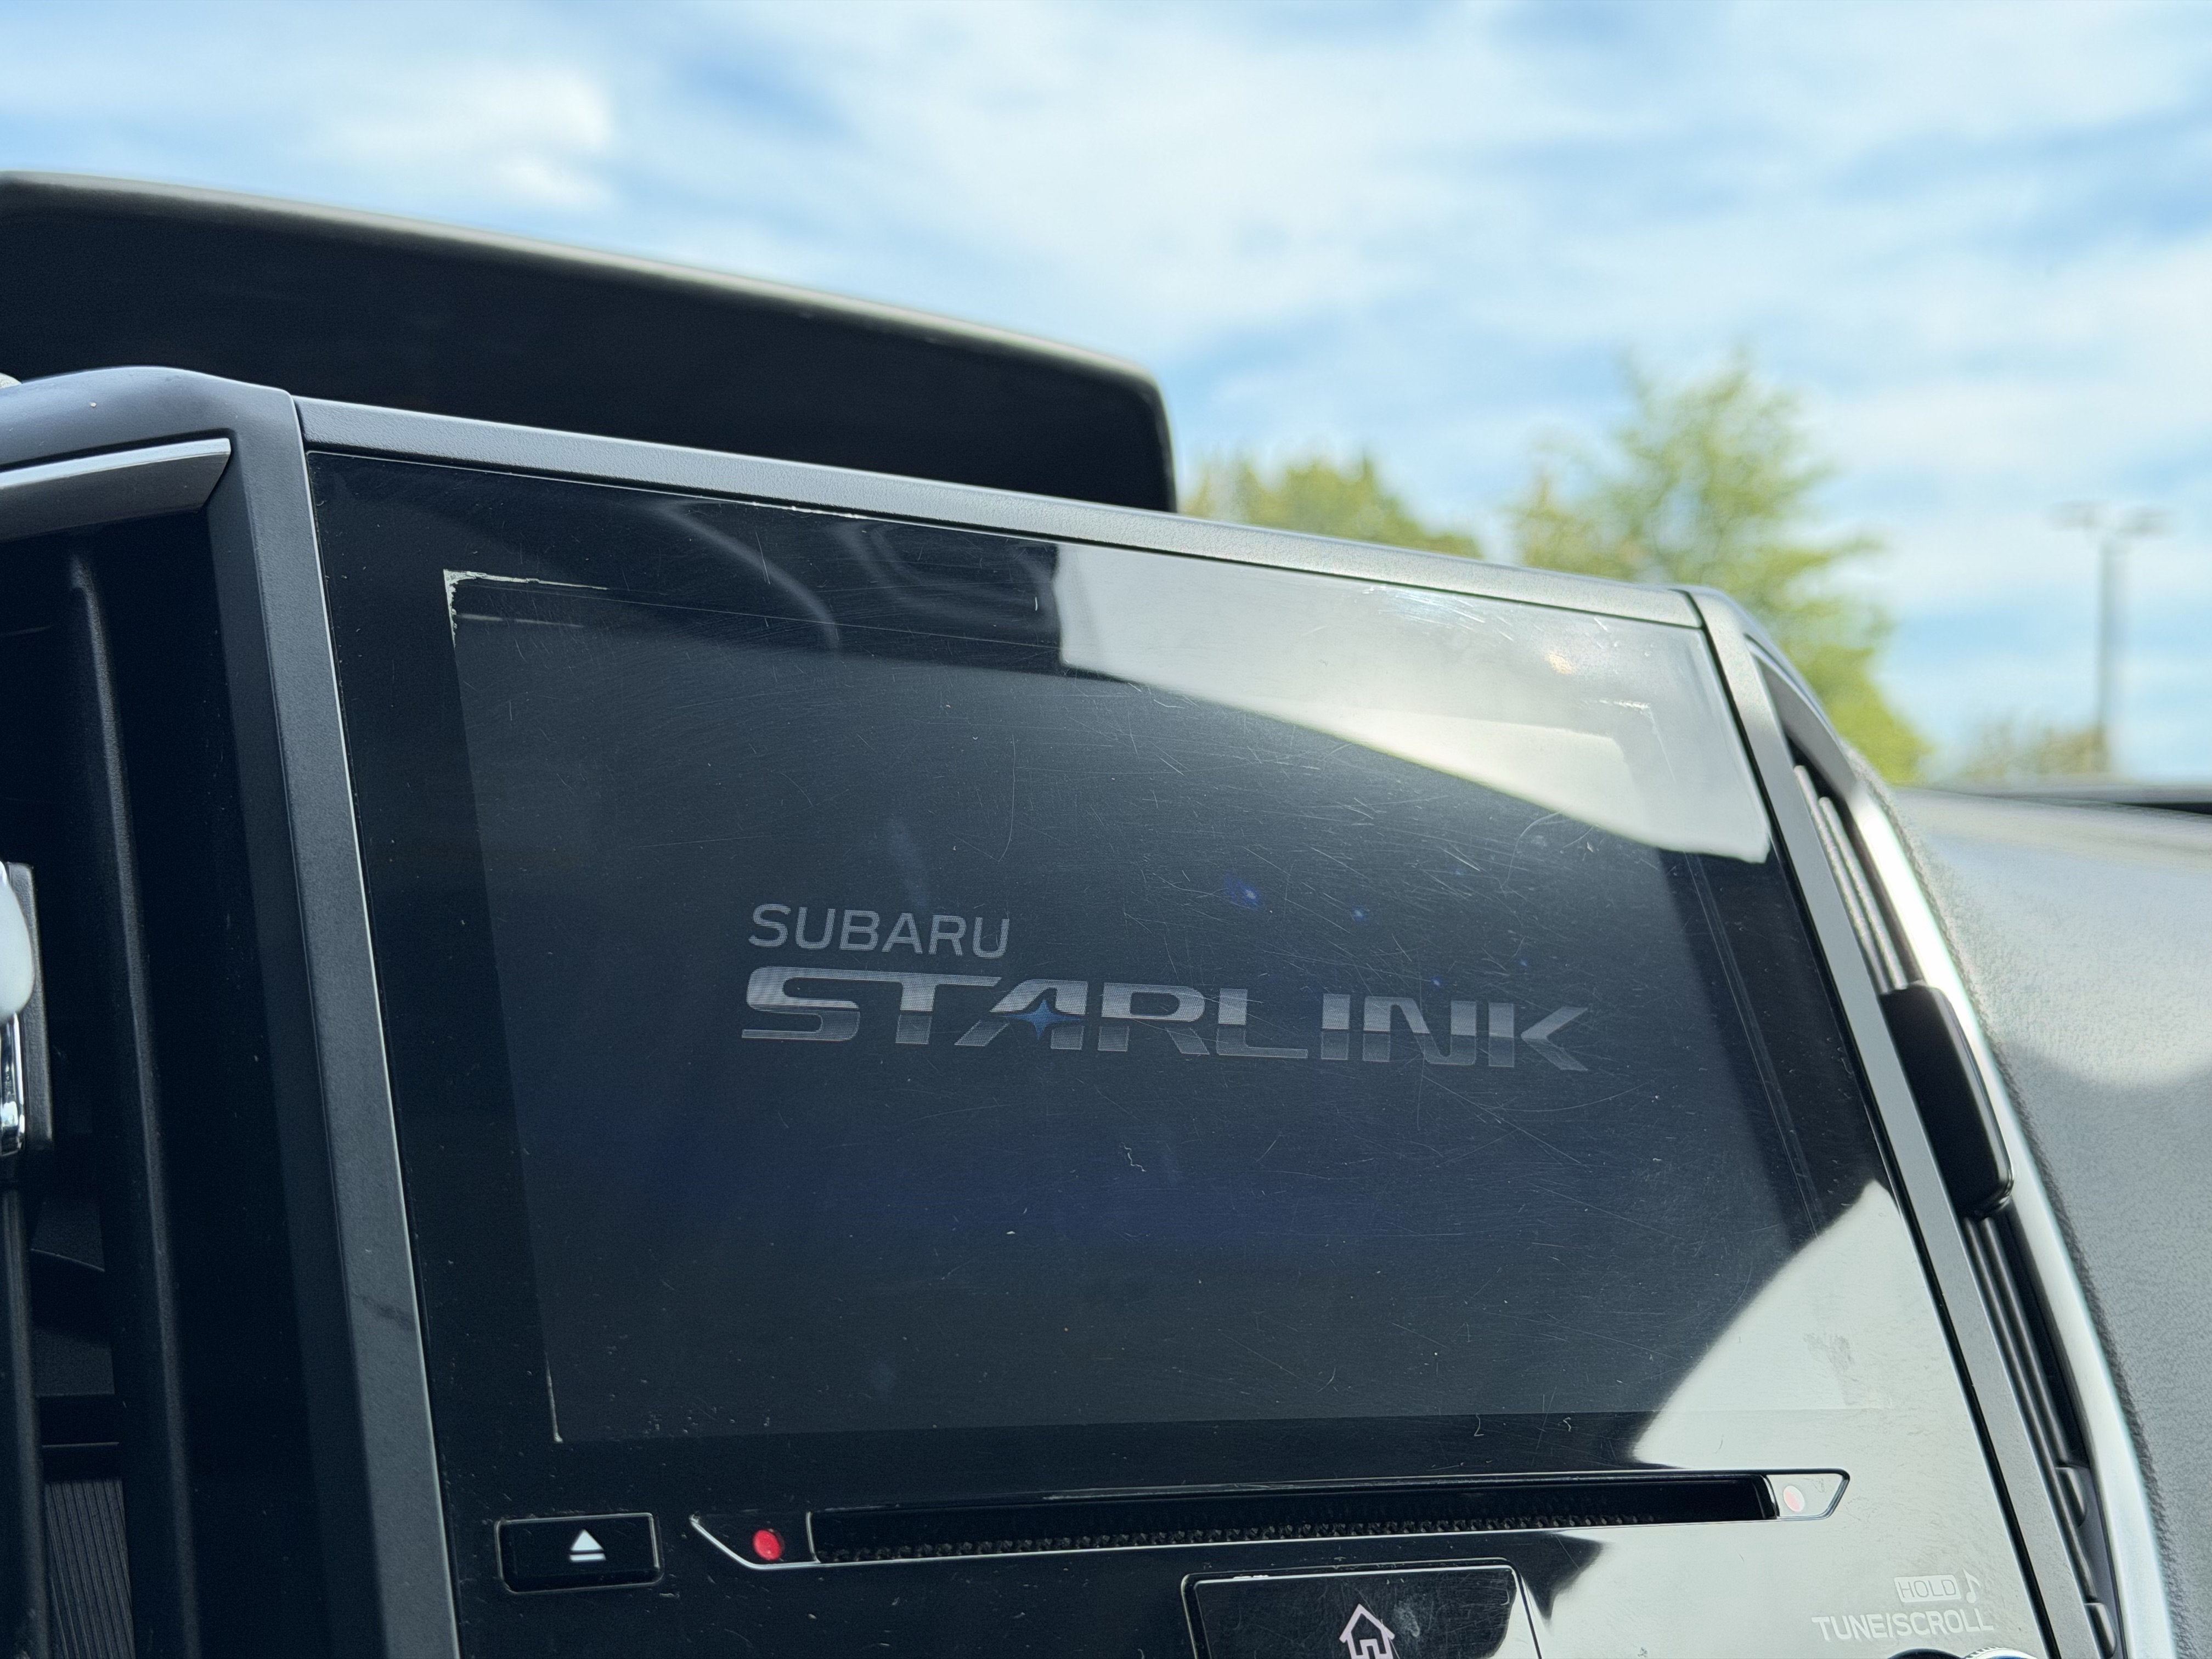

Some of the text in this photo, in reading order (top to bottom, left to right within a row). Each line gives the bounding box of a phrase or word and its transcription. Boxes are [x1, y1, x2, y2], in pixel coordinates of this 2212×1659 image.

[748, 903, 1010, 959] SUBARU
[741, 965, 1589, 1072] STARLINK
[1898, 1578, 1957, 1599] HOLD
[1811, 1607, 1994, 1643] TUNE/SCROLL
